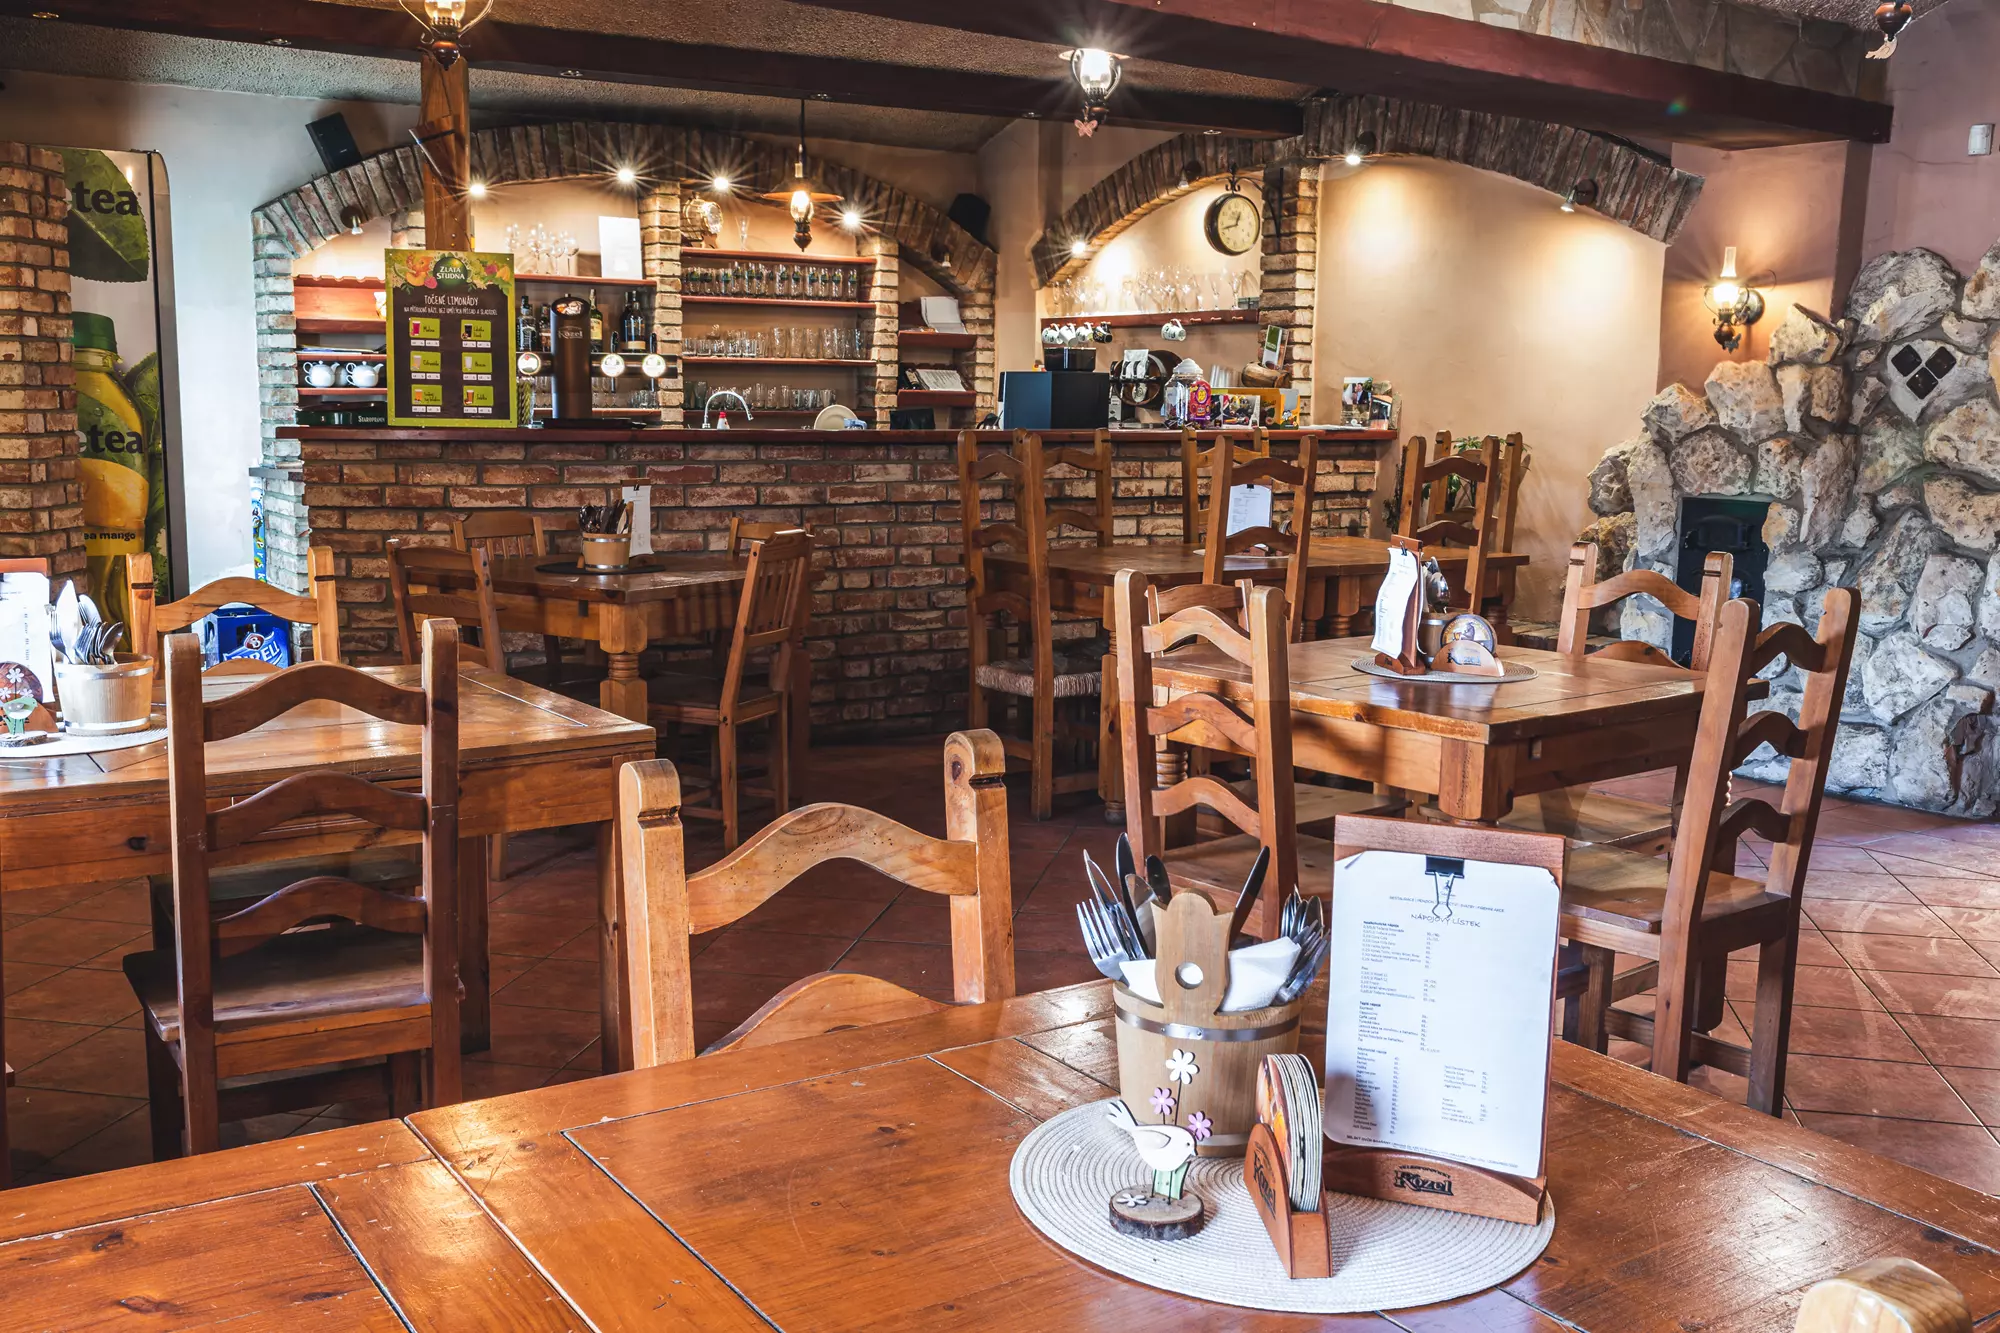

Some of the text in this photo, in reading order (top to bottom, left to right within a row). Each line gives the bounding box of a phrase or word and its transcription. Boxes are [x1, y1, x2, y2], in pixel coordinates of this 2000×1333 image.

[558, 330, 583, 339] Kozel
[100, 532, 136, 541] mango
[1452, 917, 1480, 928] LÍSTEK
[1394, 1169, 1454, 1196] Kozel
